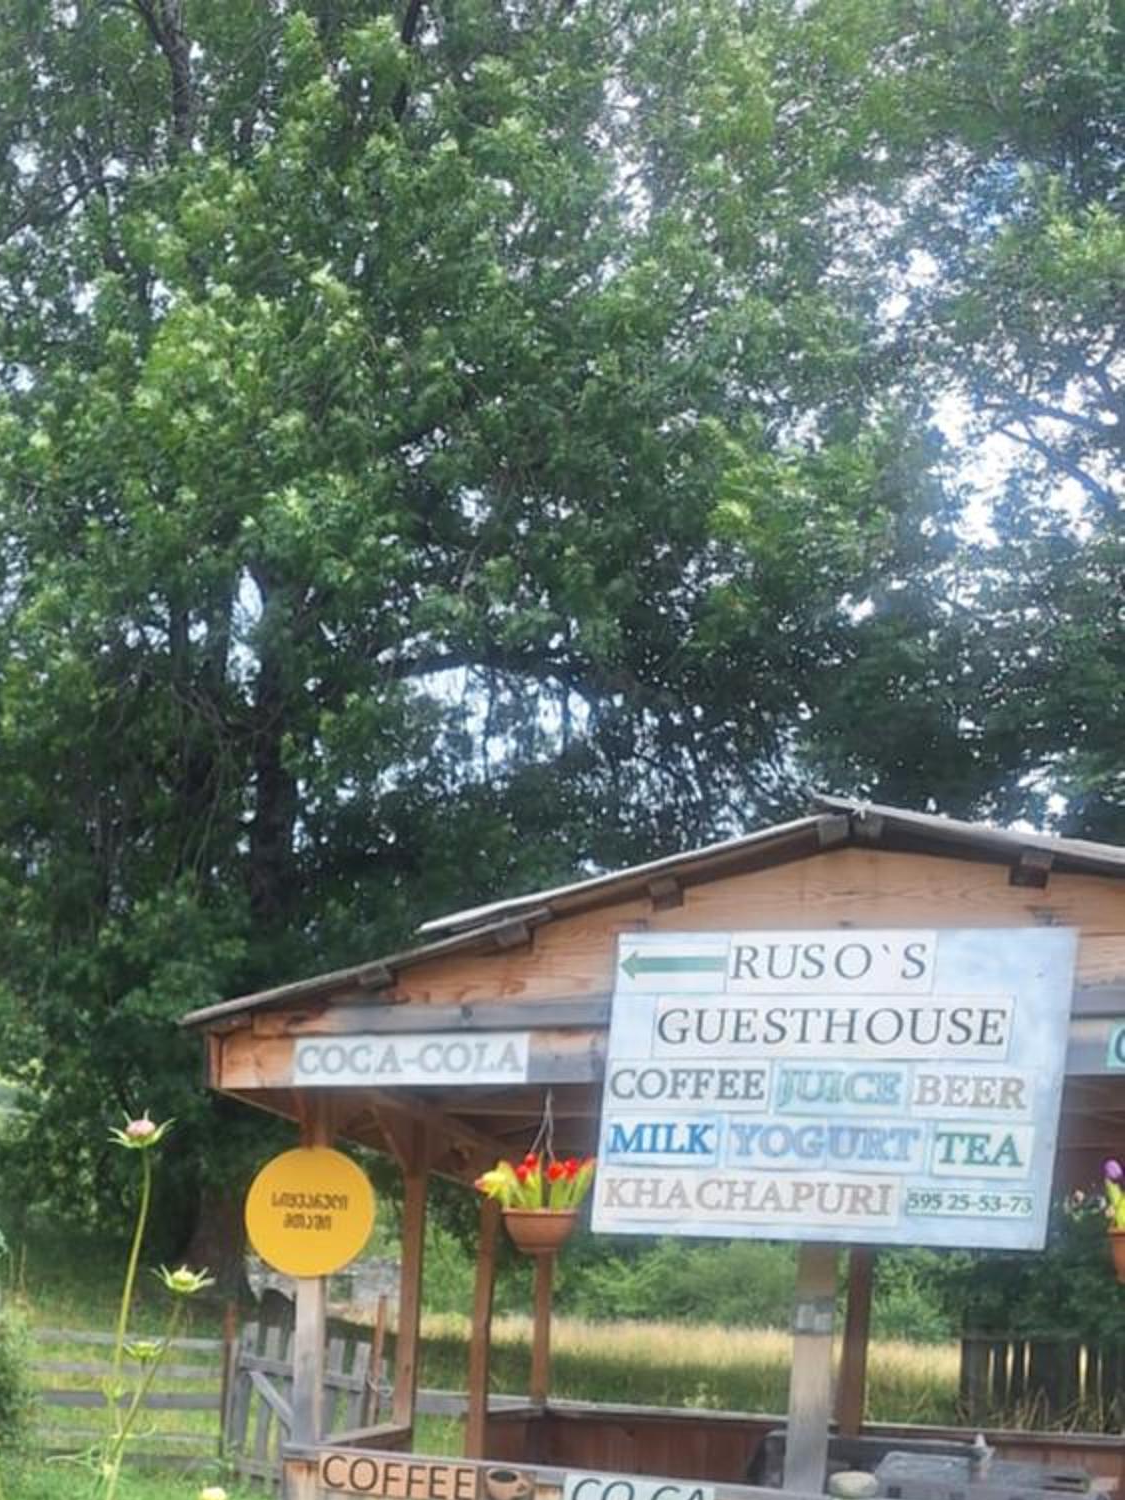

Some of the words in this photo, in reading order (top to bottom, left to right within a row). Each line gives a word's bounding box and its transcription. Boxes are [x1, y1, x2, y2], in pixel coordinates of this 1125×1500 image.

[657, 1008, 1007, 1046] GUESTHOUSE
[297, 1041, 525, 1075] COCA-COLA
[609, 1068, 766, 1101] COFFEE
[776, 1071, 902, 1106] JUICE
[913, 1074, 1027, 1110] BEER
[607, 1123, 715, 1155] MILK
[729, 1124, 921, 1161] YOGURT
[935, 1131, 1024, 1167] TEA
[602, 1178, 894, 1216] KHACHAPURI
[907, 1192, 942, 1210] 595
[946, 1193, 1033, 1214] 25-53-73
[322, 1455, 474, 1500] COFFEE
